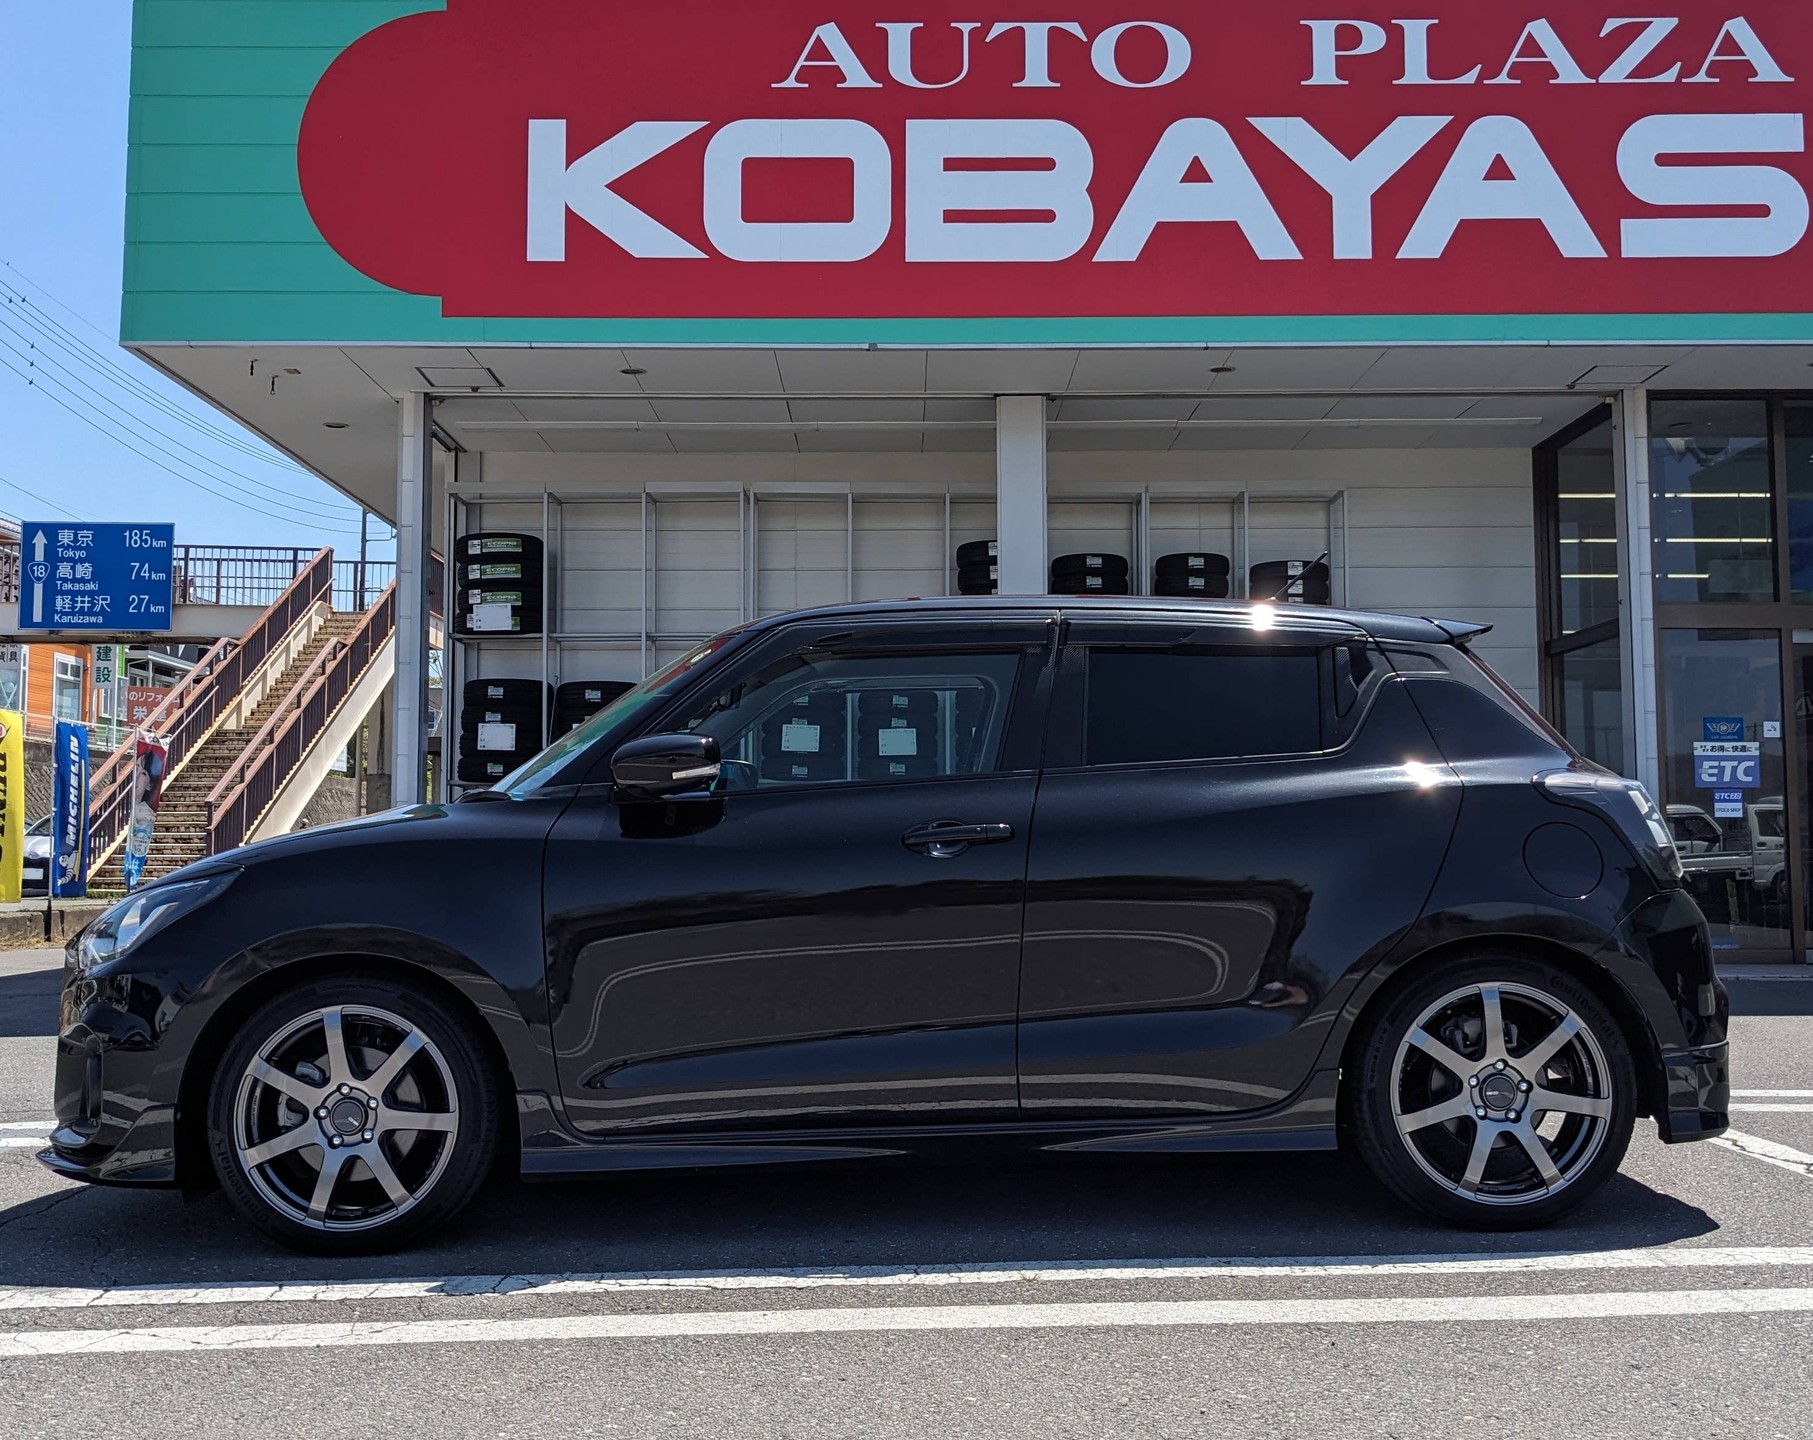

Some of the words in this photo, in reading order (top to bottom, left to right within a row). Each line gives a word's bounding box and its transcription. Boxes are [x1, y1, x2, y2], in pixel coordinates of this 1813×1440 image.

[770, 20, 1191, 89] AUTO
[1299, 16, 1794, 86] PLAZA
[526, 113, 1809, 263] KOBAYAS
[57, 529, 94, 547] 東京
[57, 549, 86, 560] Tokyo
[33, 565, 46, 578] 18
[56, 562, 93, 579] 高崎
[56, 581, 99, 591] Takasaki
[55, 595, 111, 612] 軽井沢
[54, 613, 103, 623] Karuizawa
[96, 645, 113, 683] 建設
[1700, 761, 1755, 782] ETC
[65, 735, 79, 847] MICHELIN
